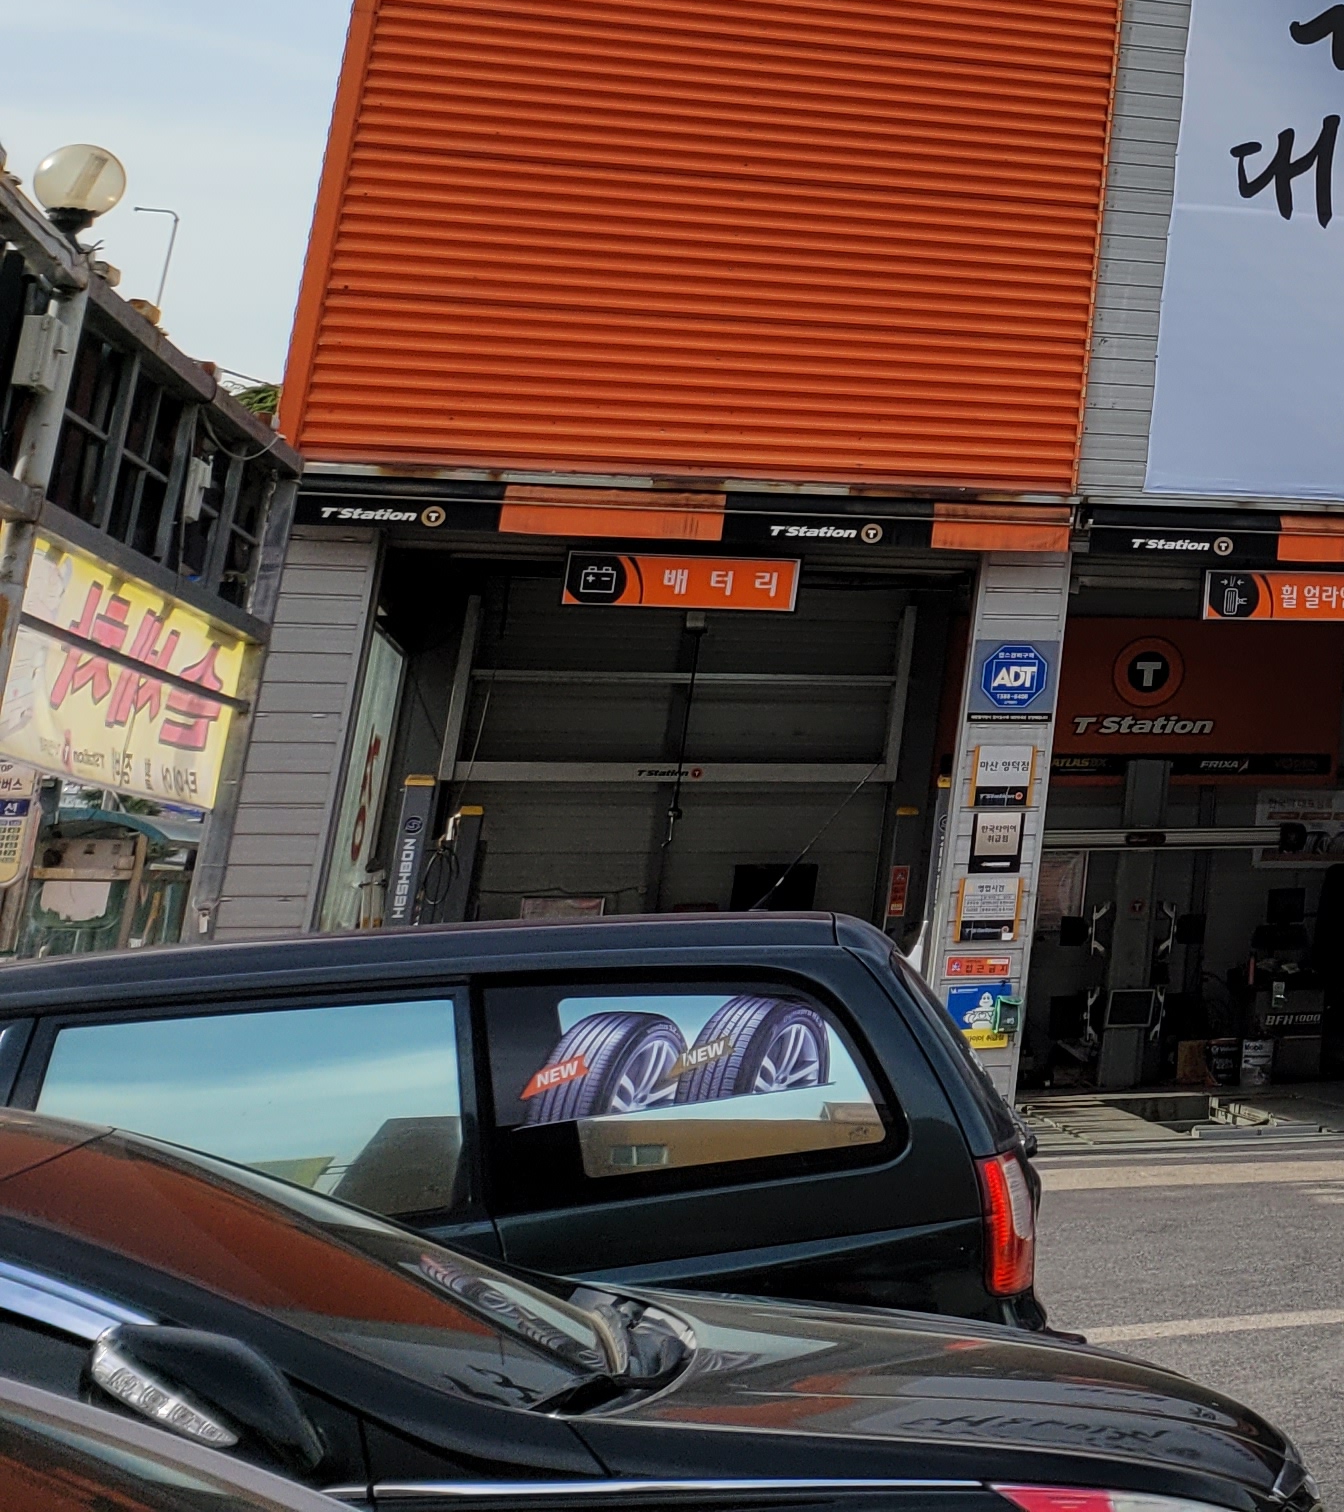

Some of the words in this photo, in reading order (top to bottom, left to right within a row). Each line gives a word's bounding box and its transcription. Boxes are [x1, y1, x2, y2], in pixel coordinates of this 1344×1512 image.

[1280, 584, 1298, 609] 휠
[992, 665, 1038, 688] ADT
[0, 764, 14, 773] OP
[980, 760, 998, 772] 마산
[1199, 760, 1240, 770] FRIXA
[0, 777, 23, 792] 버스
[391, 838, 417, 919] HESHBON
[682, 1039, 726, 1067] NEW
[536, 1061, 580, 1088] NEW
